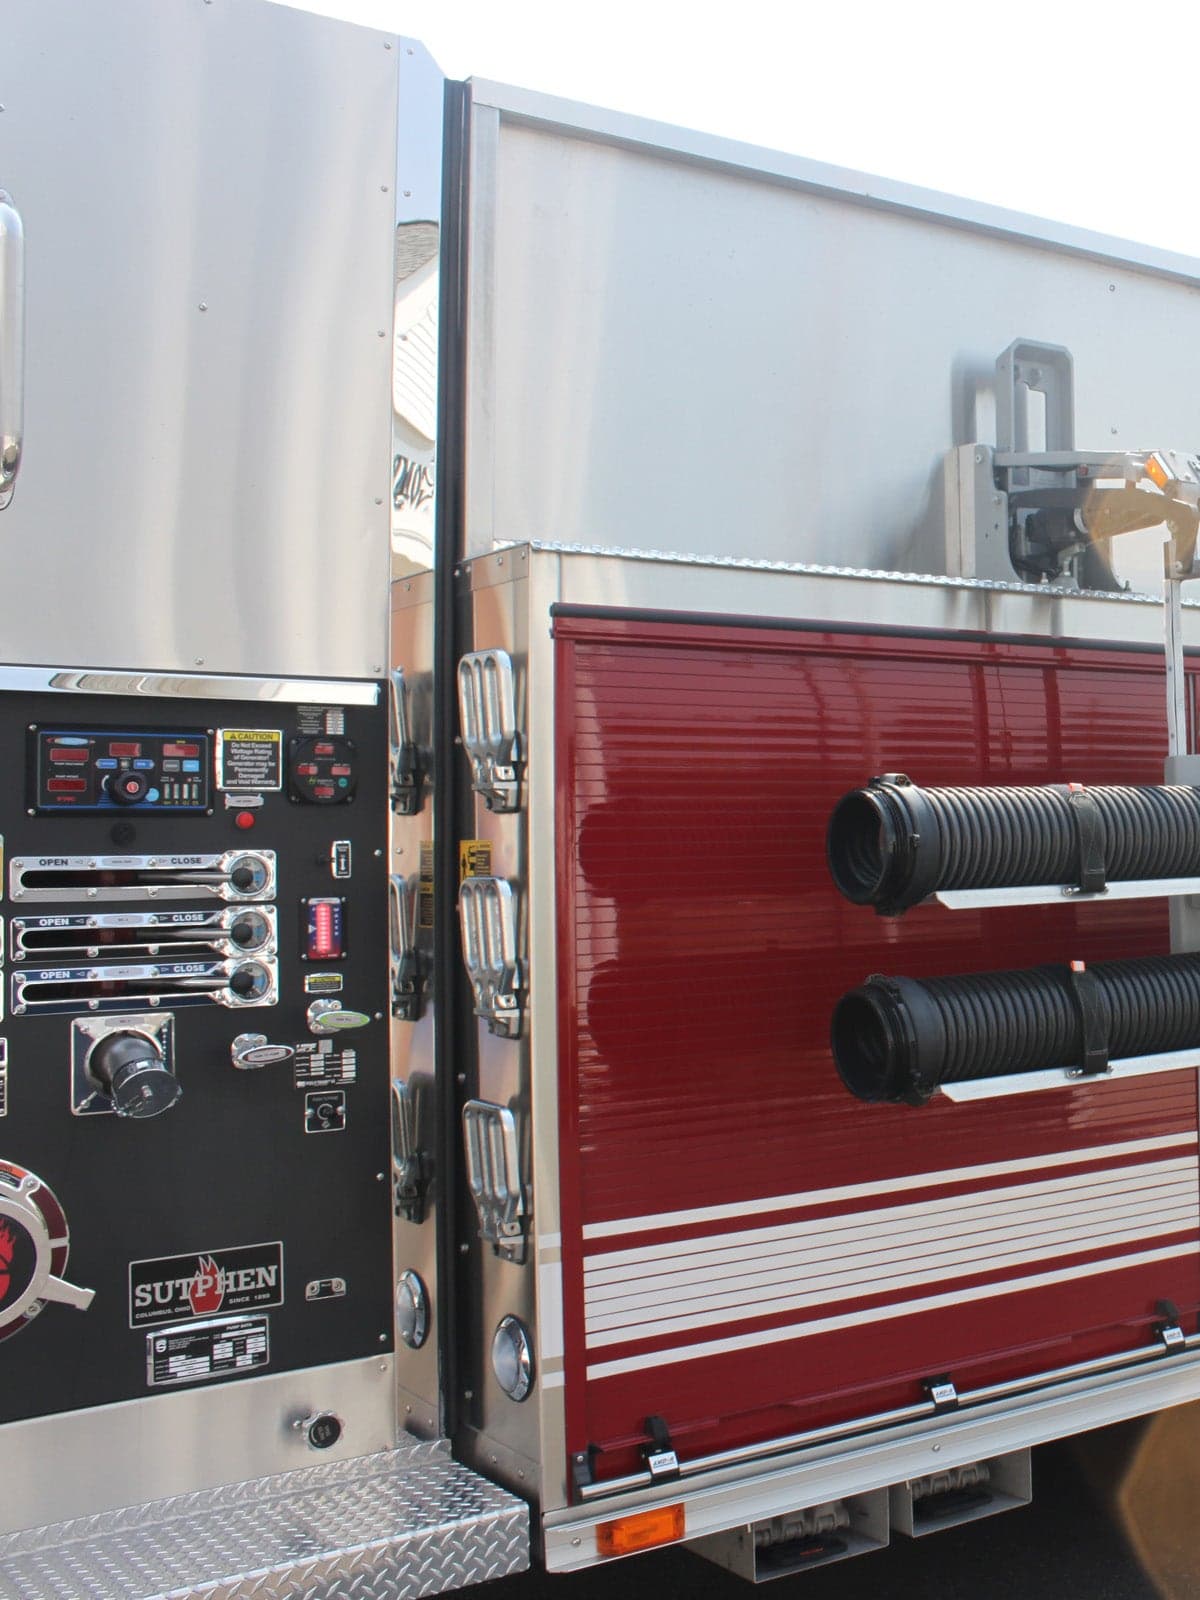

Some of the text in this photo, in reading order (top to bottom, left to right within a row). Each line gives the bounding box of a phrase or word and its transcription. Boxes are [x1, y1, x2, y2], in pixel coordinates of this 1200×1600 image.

[38, 856, 202, 866] OPEN CLOSE
[39, 913, 204, 926] OPEN CLOSE
[40, 964, 205, 979] OPEN CLOSE
[135, 1265, 278, 1307] SUTPHEN
[228, 1296, 250, 1304] SINCE
[174, 1305, 191, 1313] OHIO
